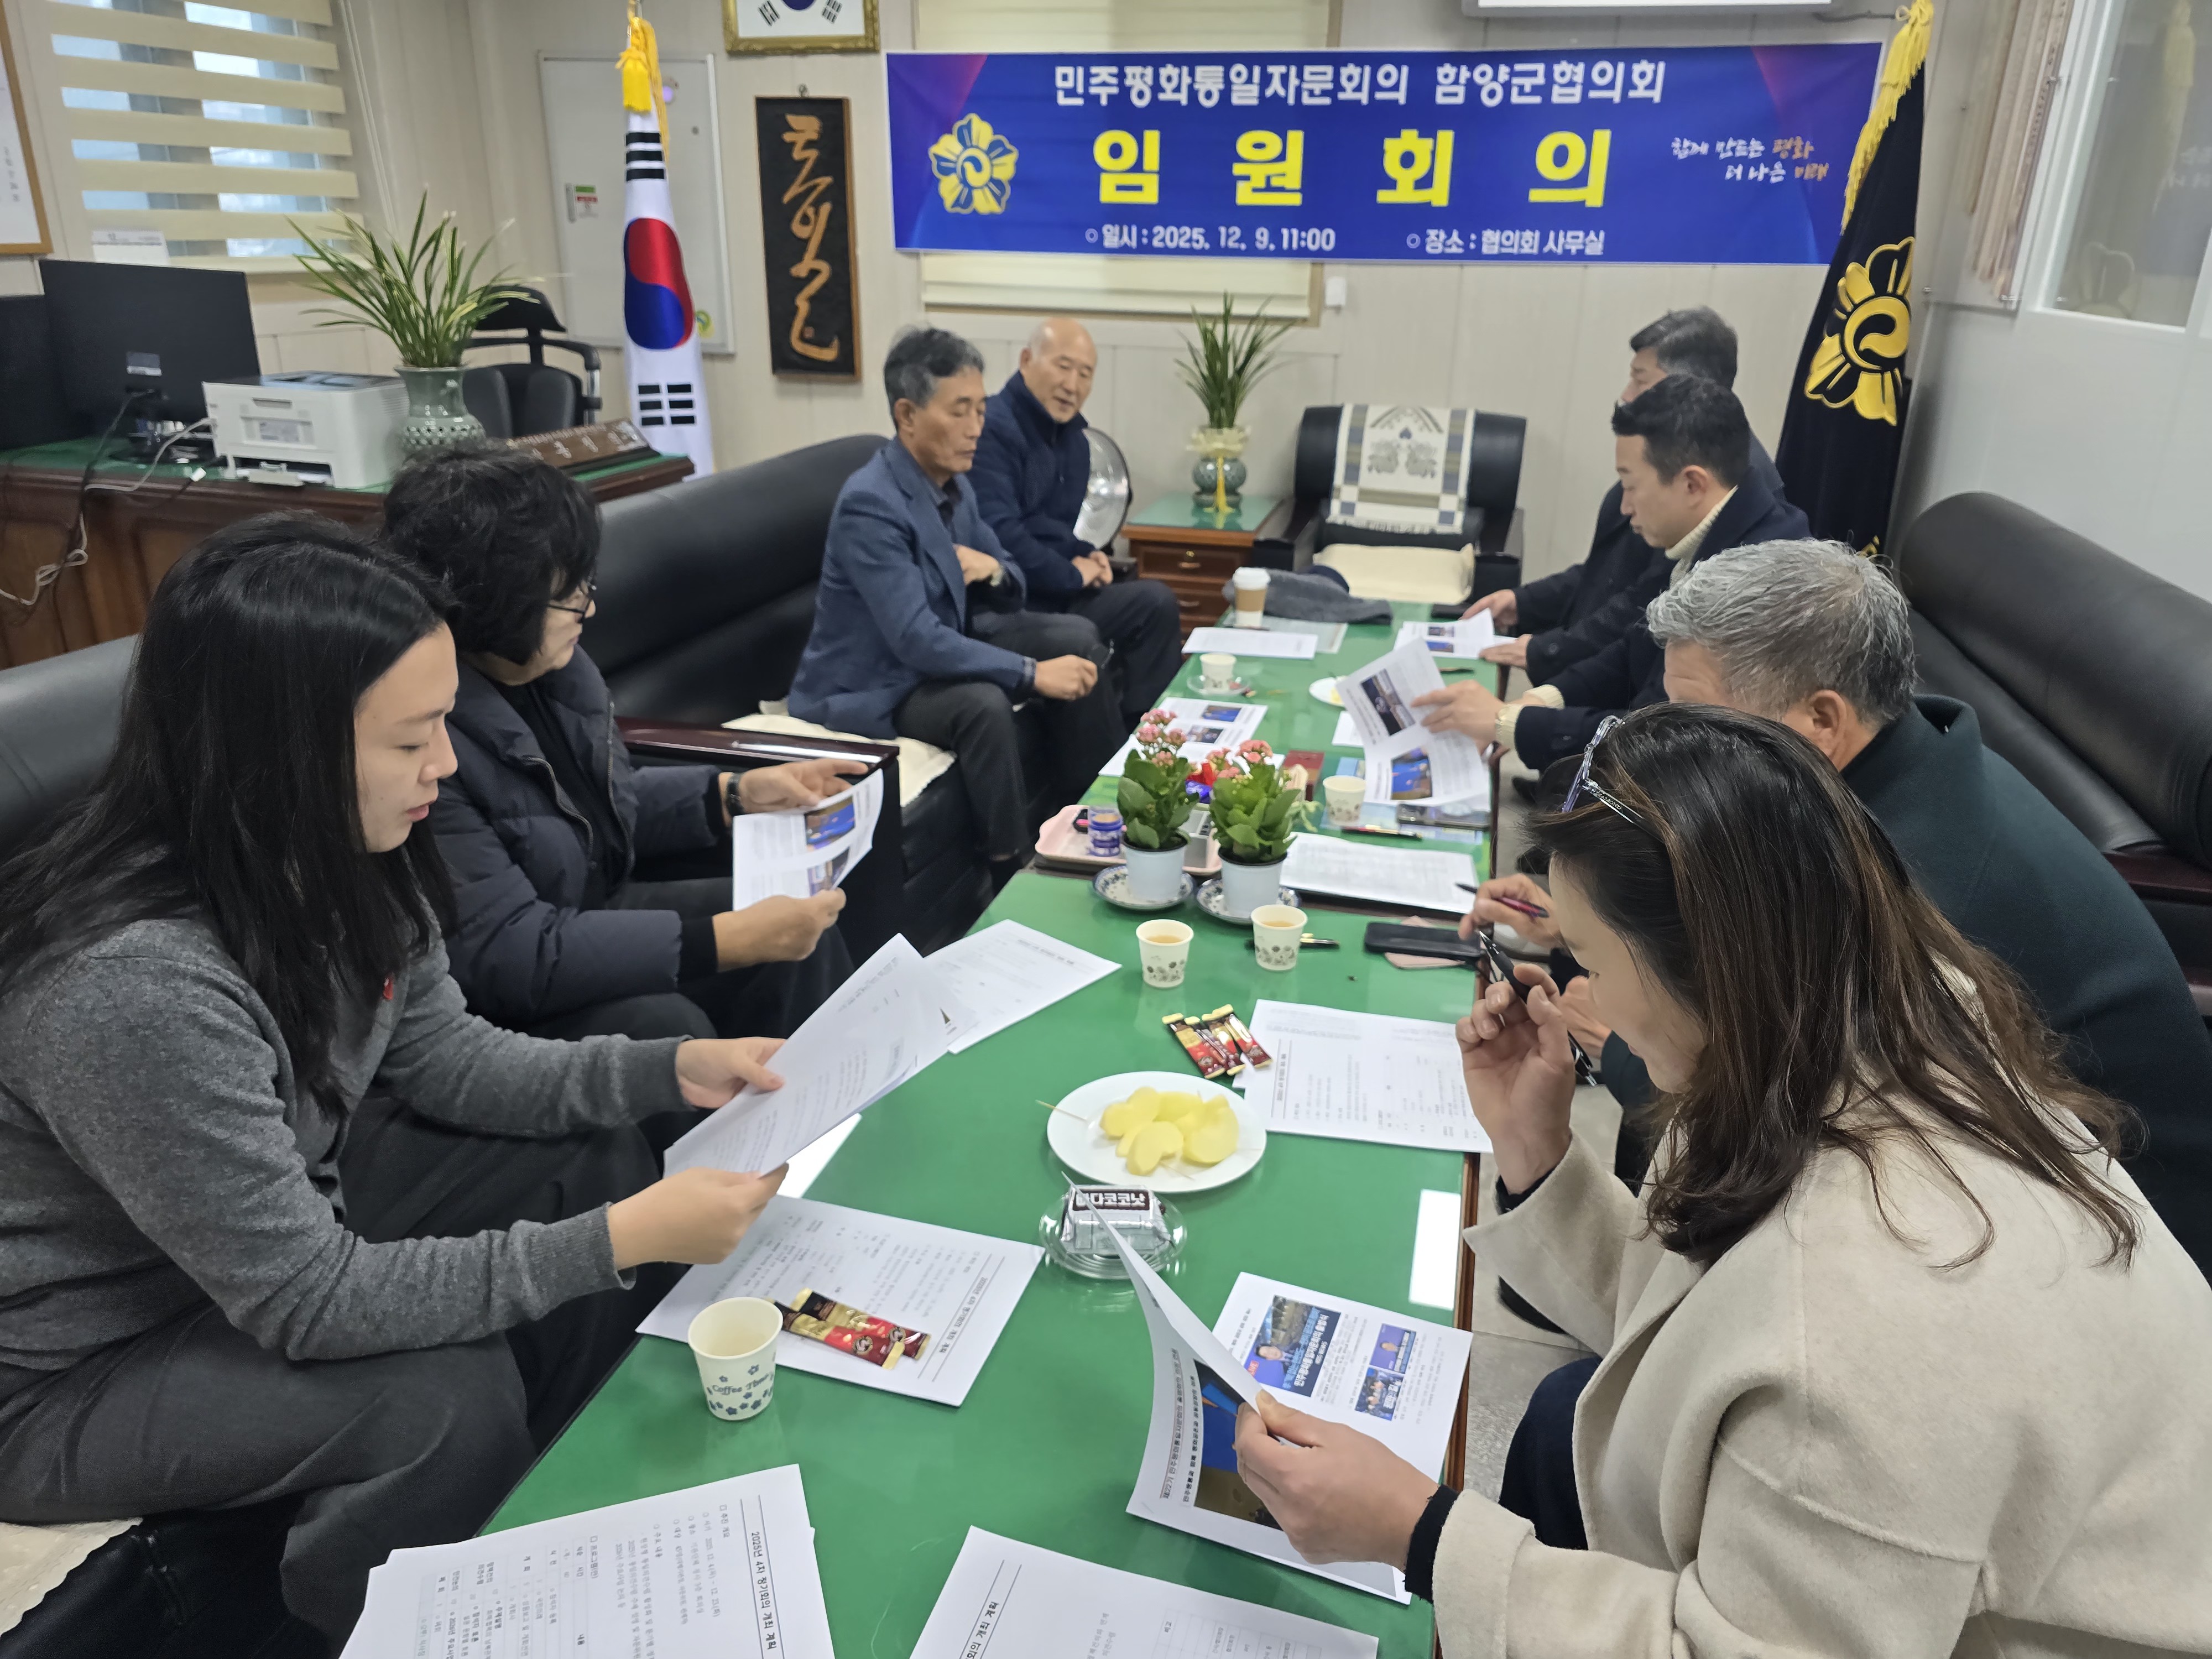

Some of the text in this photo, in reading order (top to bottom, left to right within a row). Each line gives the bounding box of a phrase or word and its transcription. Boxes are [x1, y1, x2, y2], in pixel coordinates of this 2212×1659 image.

[1055, 59, 1666, 108] 민주평화통일자문회의 함양군협의회
[1671, 137, 1710, 160] 함께
[1772, 135, 1814, 160] 평화
[1093, 128, 1611, 207] 임 원 회 의
[1724, 160, 1830, 184] 더 나은 미래
[1151, 225, 1211, 251] 2025.
[1218, 226, 1247, 251] 12.
[1281, 227, 1336, 252] 11:00
[1481, 228, 1540, 255] 협의회
[1542, 229, 1605, 256] 사무실
[752, 1532, 776, 1650] 2025년 4차 정기회의 개최 계획
[976, 1621, 990, 1637] 개최
[985, 1601, 1000, 1618] 계획
